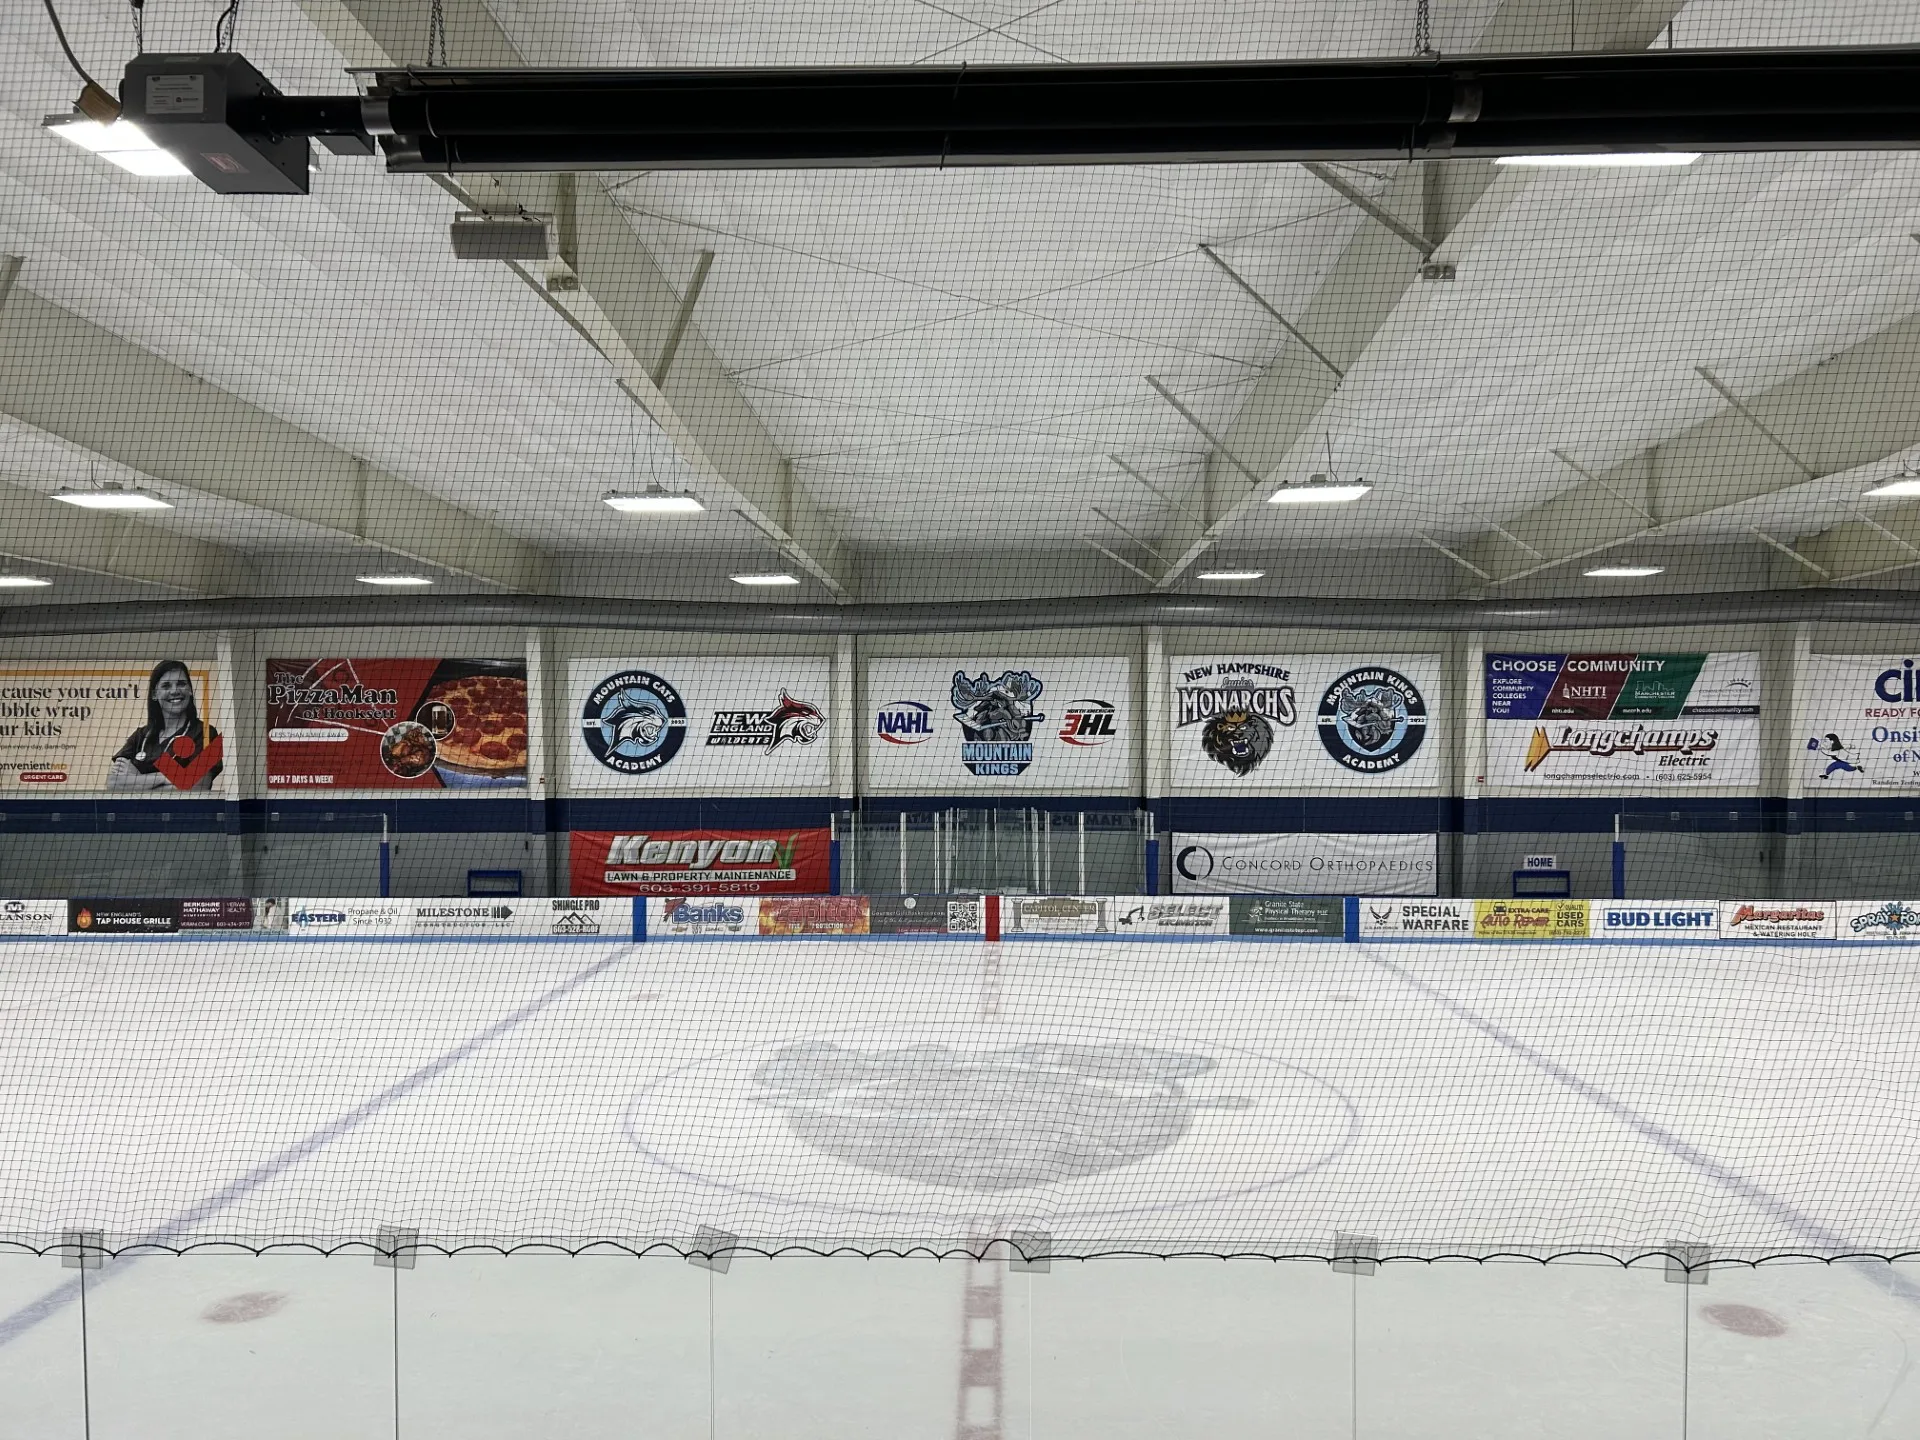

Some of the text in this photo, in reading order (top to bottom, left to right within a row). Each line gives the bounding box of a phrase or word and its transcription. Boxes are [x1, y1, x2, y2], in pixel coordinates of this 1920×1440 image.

[1184, 662, 1290, 682] NEW HAMPSHIRE
[1492, 660, 1665, 672] CHOOSE COMMUNITY
[1875, 659, 1920, 702] ci
[58, 687, 90, 702] you
[96, 684, 140, 699] can't
[593, 675, 676, 704] MOUNTAIN CATS
[1326, 671, 1418, 705] MOUNTAIN KINGS
[1571, 686, 1607, 697] NHTI
[46, 705, 91, 720] wrap
[303, 706, 397, 720] of Hooksett
[1176, 686, 1297, 728] MONARCHS
[1865, 708, 1905, 717] READY
[716, 713, 767, 724] NEW
[877, 711, 934, 734] NAHL
[24, 721, 62, 735] kids
[1872, 726, 1920, 742] Onsi
[1552, 724, 1718, 757] Longchamps
[962, 743, 1032, 761] MOUNTAIN
[606, 754, 662, 770] ACADEMY
[1342, 753, 1400, 769] ACADEMY
[1658, 754, 1711, 766] Electric
[975, 763, 1019, 775] KINGS
[1655, 773, 1675, 781] (603)
[605, 835, 778, 870] Kenyon
[1527, 858, 1553, 867] HOME
[607, 873, 638, 881] LAWN
[653, 872, 711, 881] PROPERTY
[714, 870, 791, 880] MAINTENANCE
[552, 900, 599, 910] SHINGLE PRO
[1403, 906, 1460, 917] SPECIAL
[292, 913, 346, 922] EASTERN
[417, 908, 490, 918] MILESTONE
[672, 902, 744, 924] Banks
[1607, 912, 1714, 926] BUD LIGHT
[1731, 904, 1824, 926] Margaritas
[353, 917, 392, 925] Since 1932
[1403, 920, 1469, 930] WARFARE
[1850, 910, 1891, 932] SPRAY
